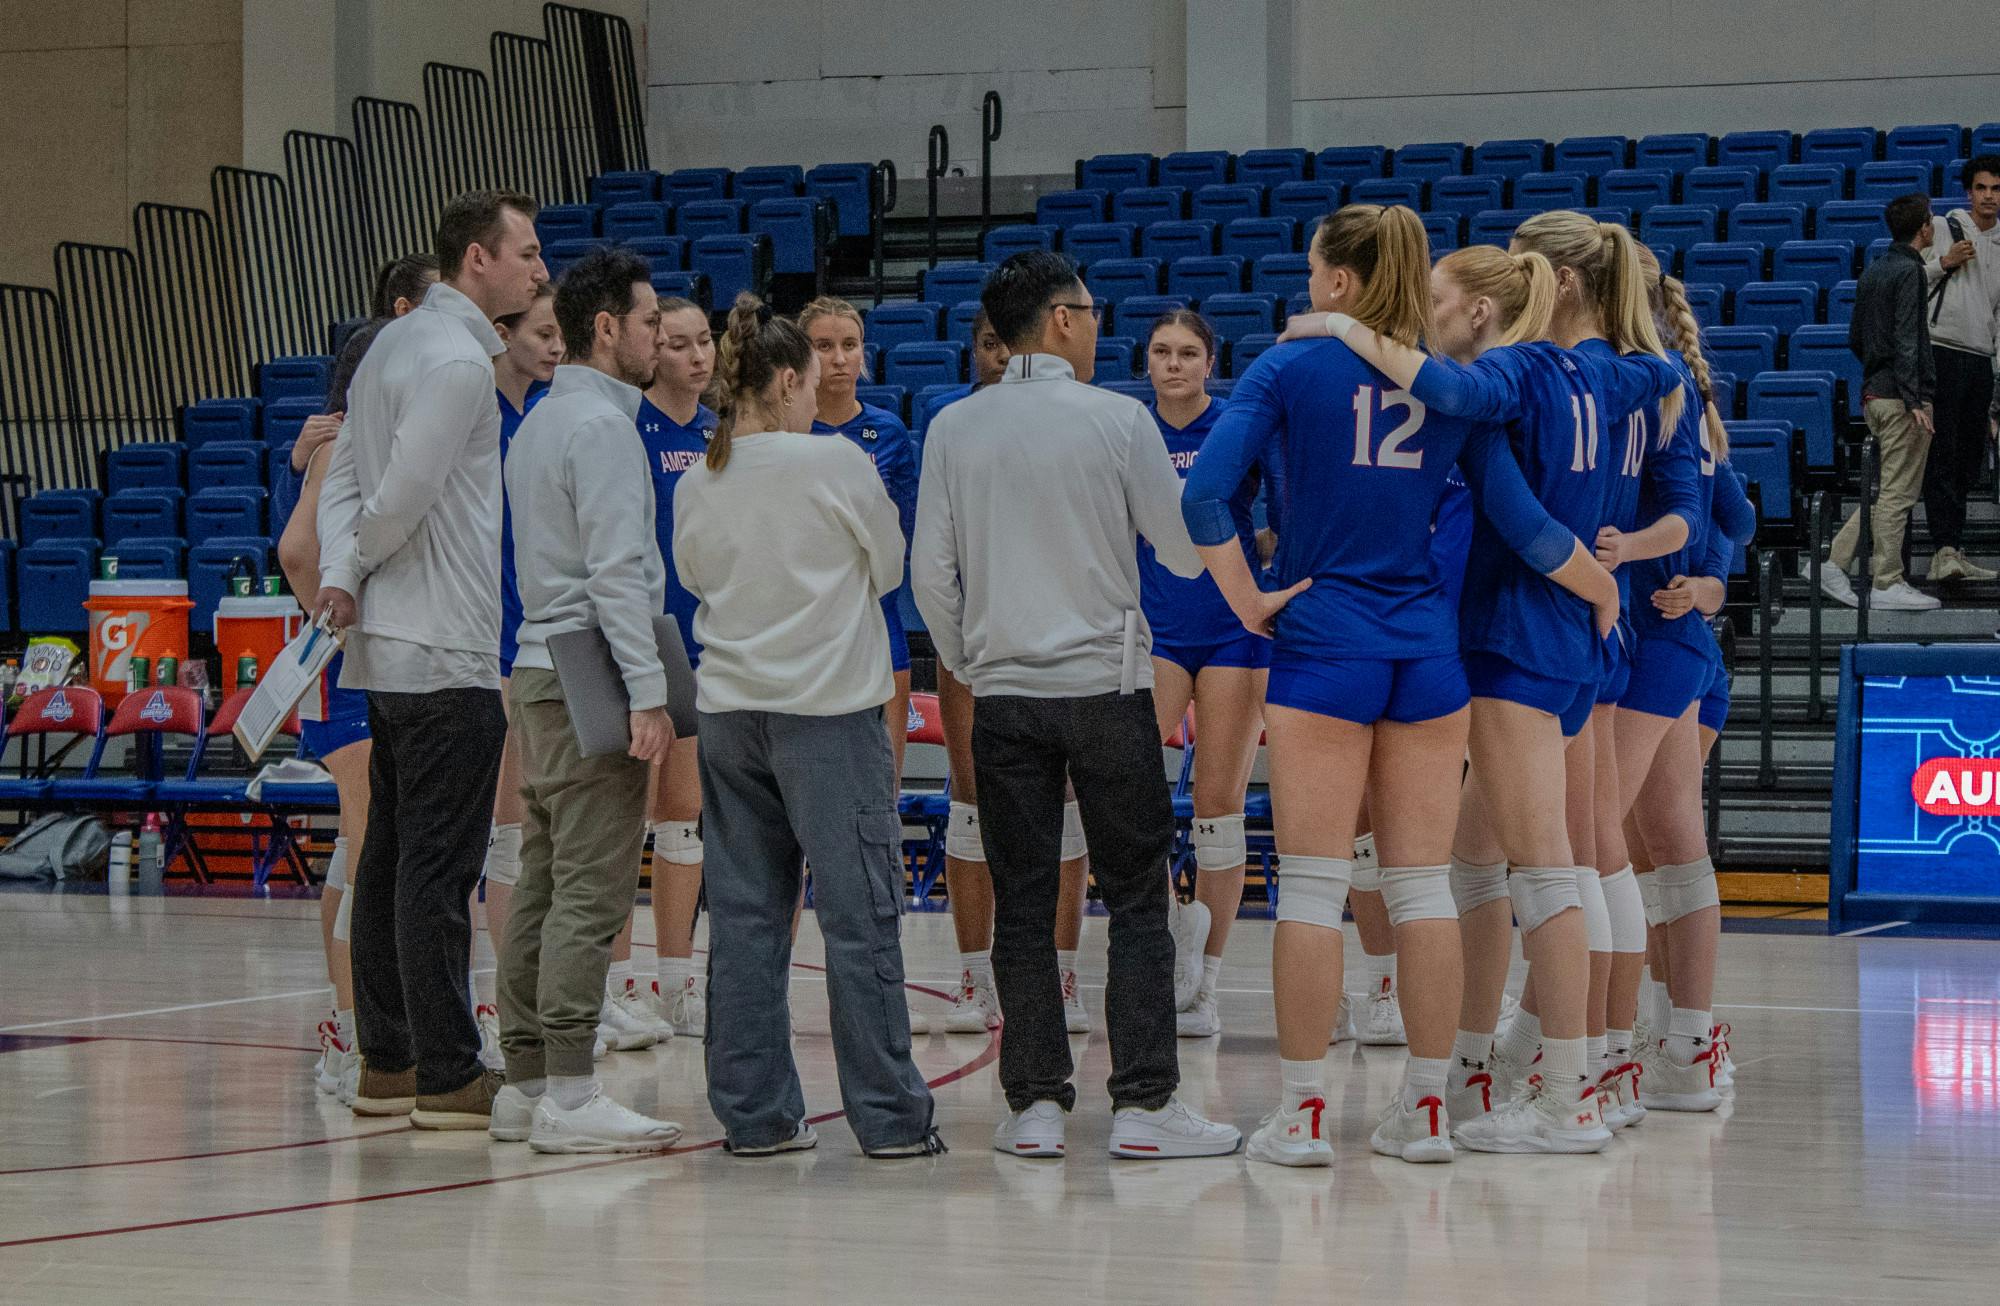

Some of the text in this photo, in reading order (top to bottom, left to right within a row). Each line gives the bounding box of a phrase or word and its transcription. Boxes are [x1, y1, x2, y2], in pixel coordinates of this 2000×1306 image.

[862, 428, 878, 440] BG
[1351, 384, 1426, 469] 12
[1570, 392, 1598, 472] 11
[1621, 407, 1647, 478] 10
[108, 562, 118, 575] G
[240, 582, 250, 594] G
[101, 617, 127, 650] G
[247, 665, 257, 680] G
[1924, 770, 2000, 806] AU
